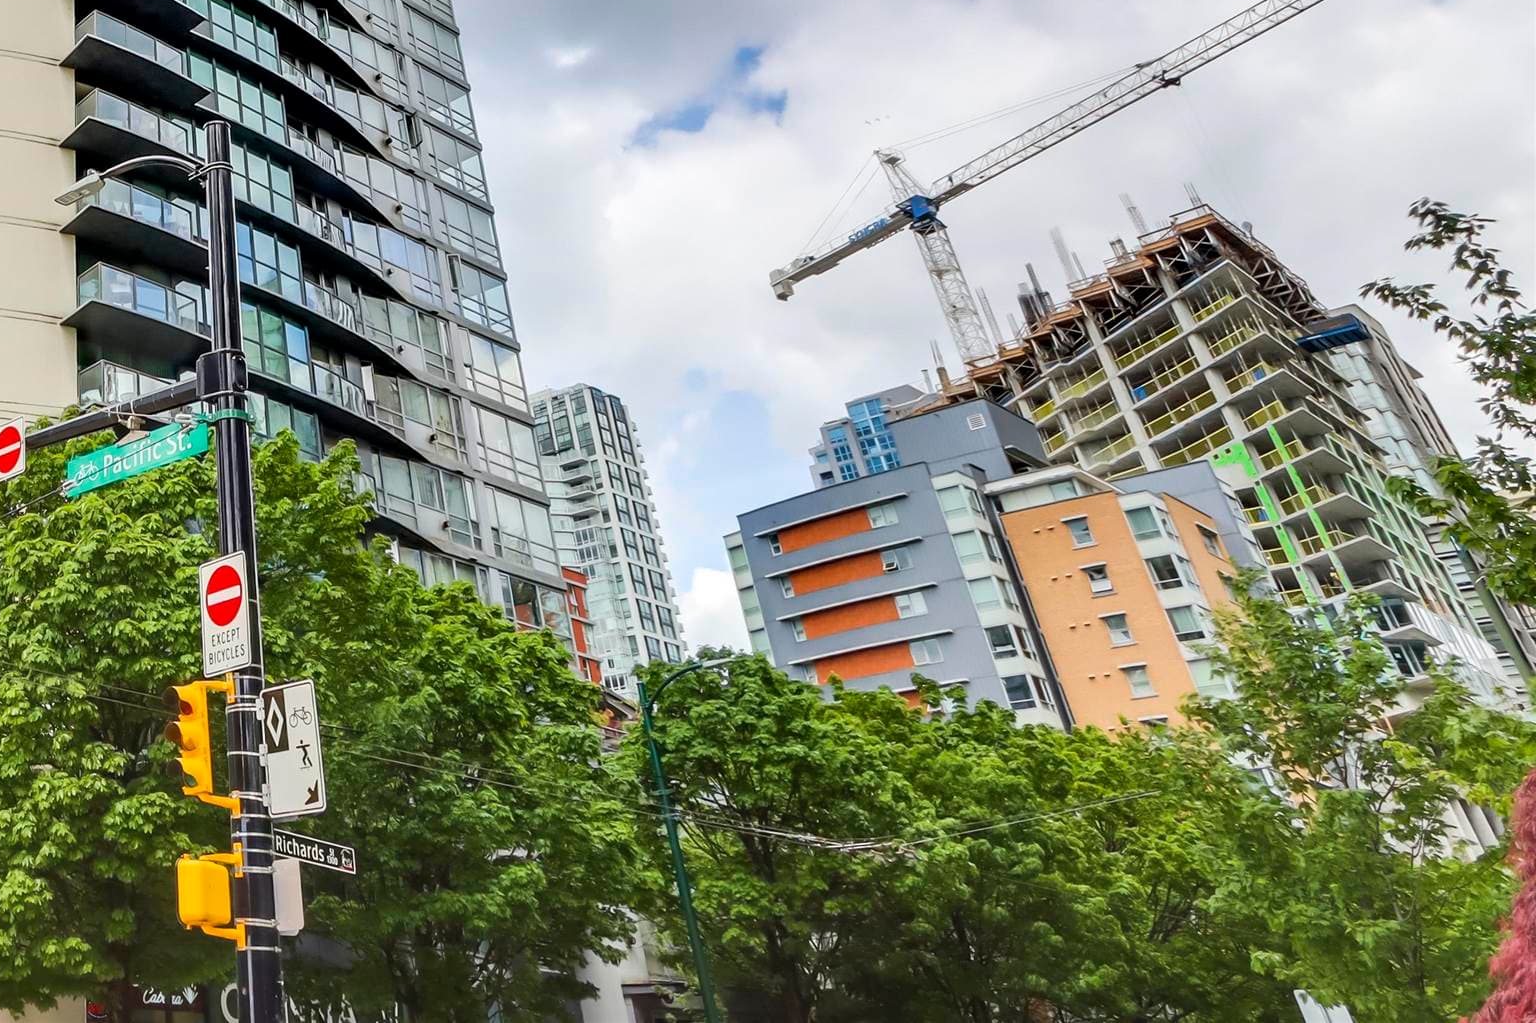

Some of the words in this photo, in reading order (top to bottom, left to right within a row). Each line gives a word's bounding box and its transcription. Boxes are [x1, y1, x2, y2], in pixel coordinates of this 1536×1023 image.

[104, 438, 162, 477] Pacific
[211, 627, 240, 647] EXCEPT
[208, 643, 246, 665] BICYCLES
[275, 835, 325, 863] Richards
